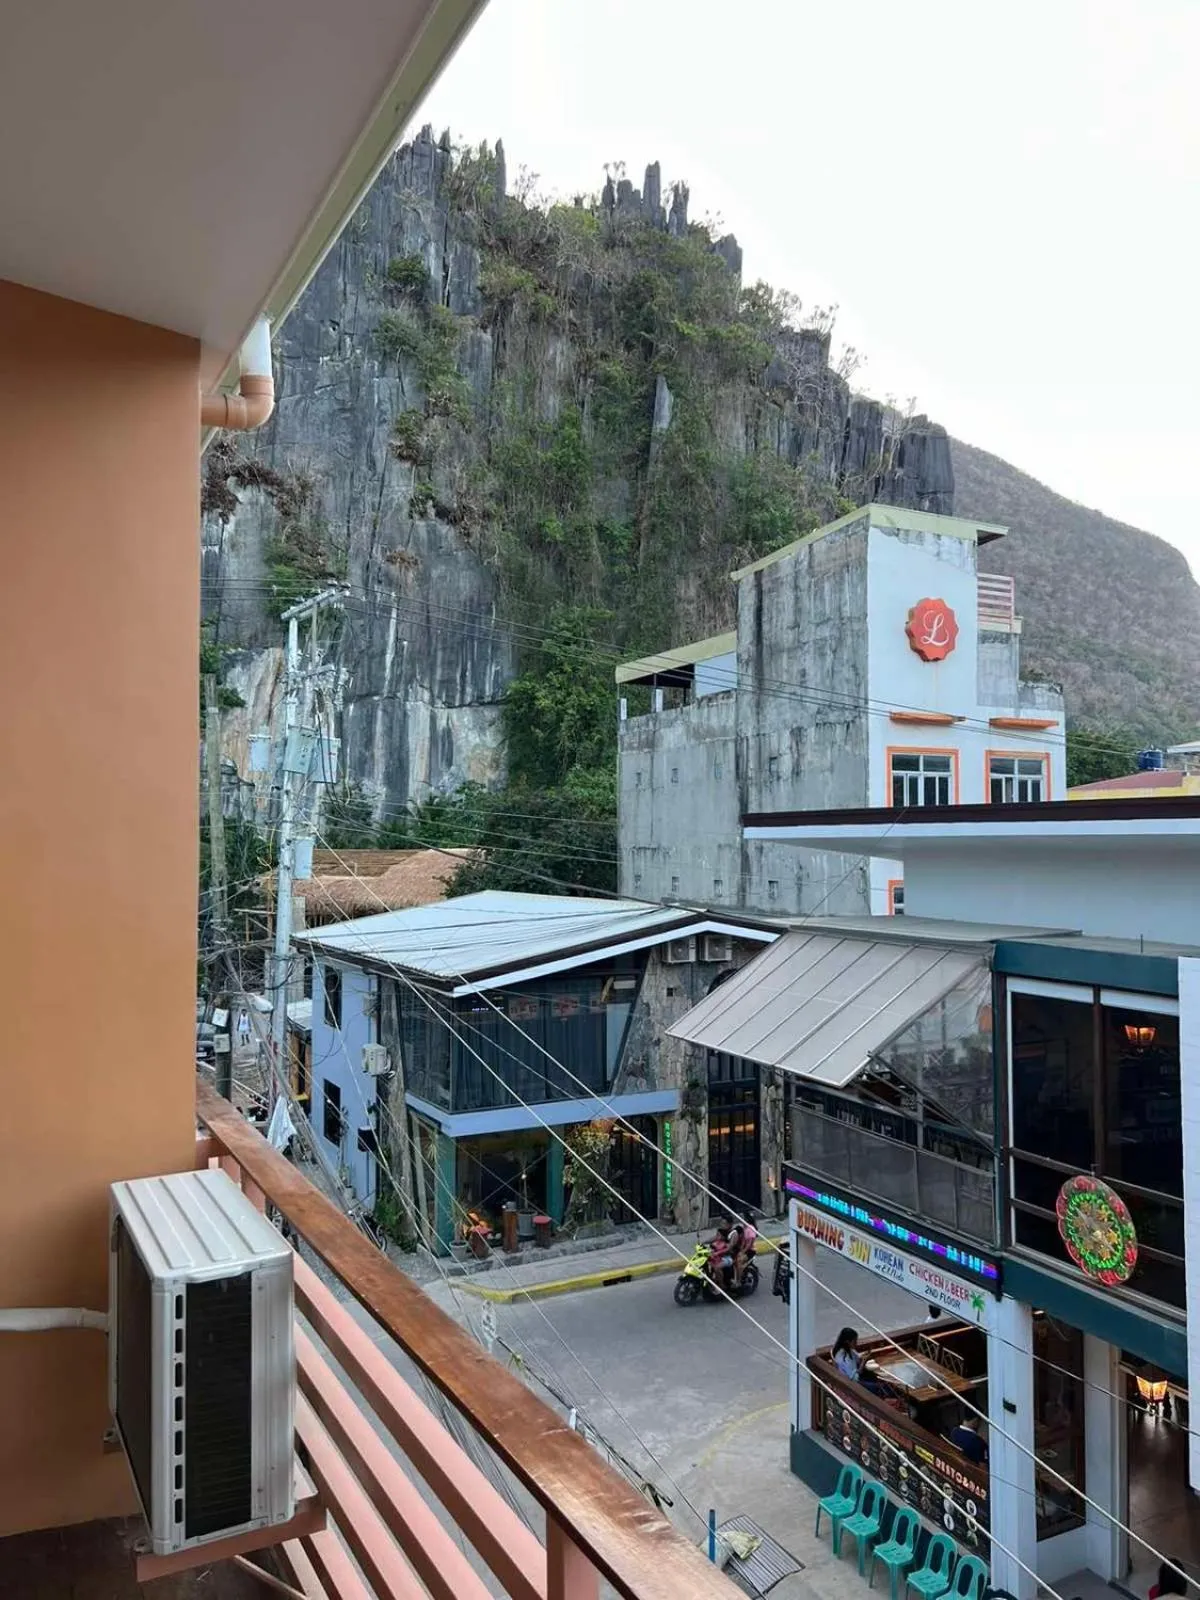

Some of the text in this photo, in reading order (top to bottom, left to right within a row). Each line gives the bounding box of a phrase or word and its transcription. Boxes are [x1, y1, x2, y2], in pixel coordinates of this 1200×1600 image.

[920, 609, 950, 646] L
[797, 1207, 845, 1251] BURNING
[848, 1234, 872, 1265] SUN
[873, 1247, 904, 1272] KOREAN
[909, 1262, 945, 1290] CHICKEN
[950, 1282, 970, 1302] BEER
[924, 1284, 961, 1310] 2ND FLOOR
